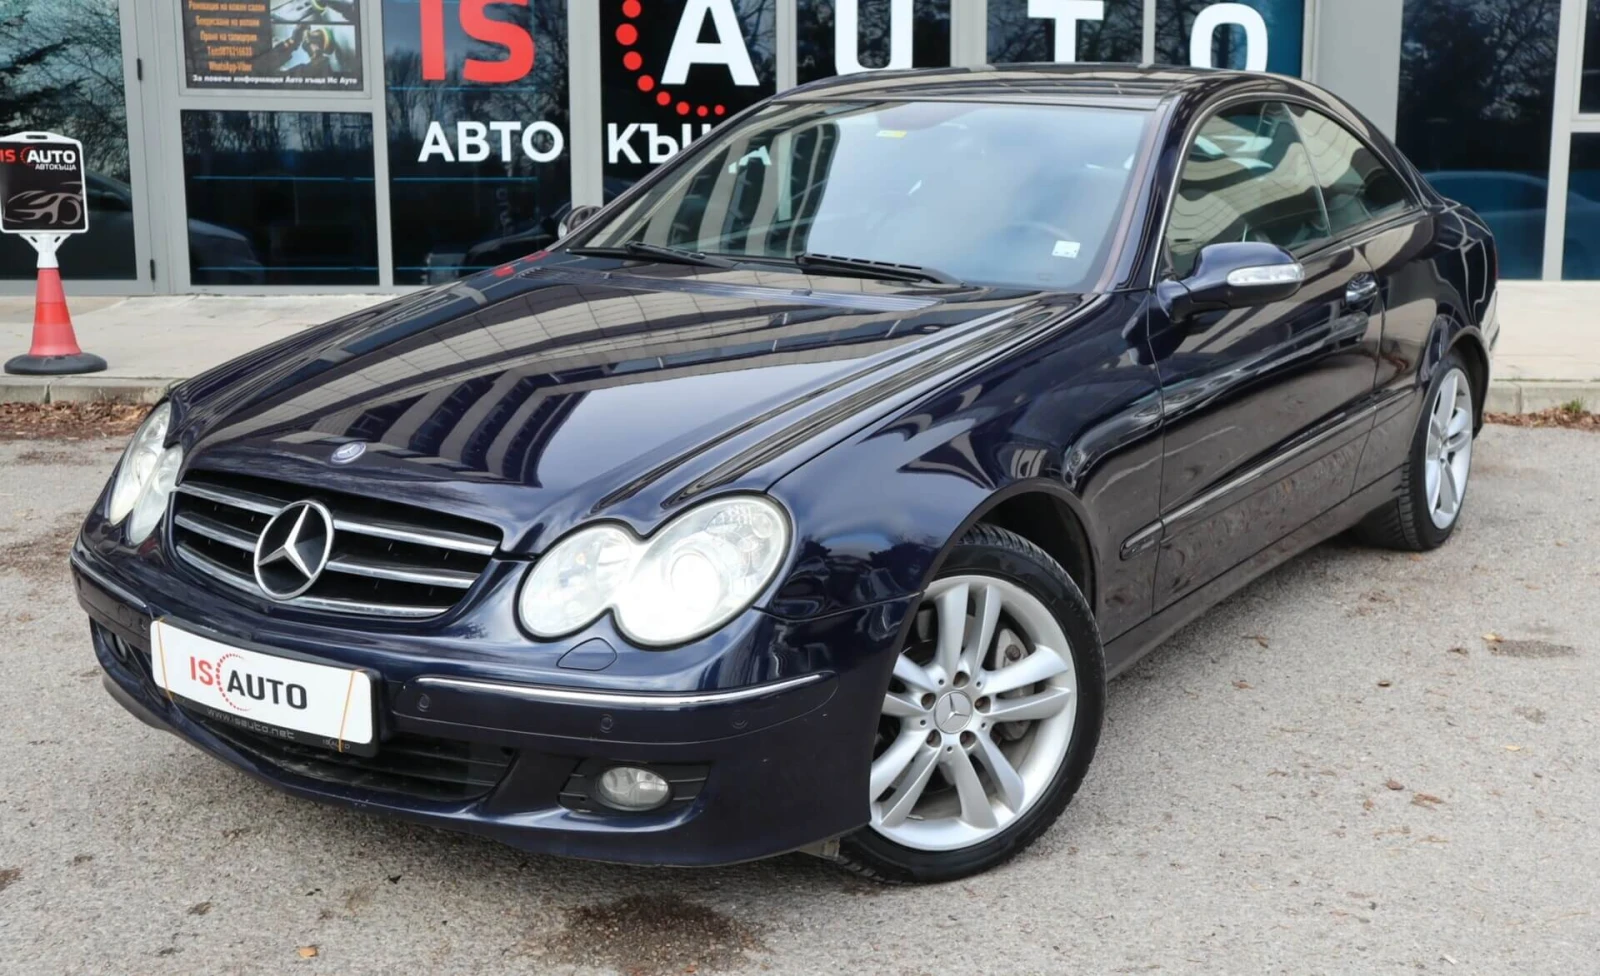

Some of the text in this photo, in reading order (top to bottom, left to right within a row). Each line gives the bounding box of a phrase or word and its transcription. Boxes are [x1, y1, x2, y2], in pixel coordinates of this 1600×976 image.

[419, 0, 1268, 87] IS AUTO
[192, 74, 203, 82] За
[0, 149, 76, 164] IS AUTO
[418, 121, 564, 163] АВТО
[190, 656, 307, 710] IS AUTO
[207, 707, 295, 740] www.isauto.net
